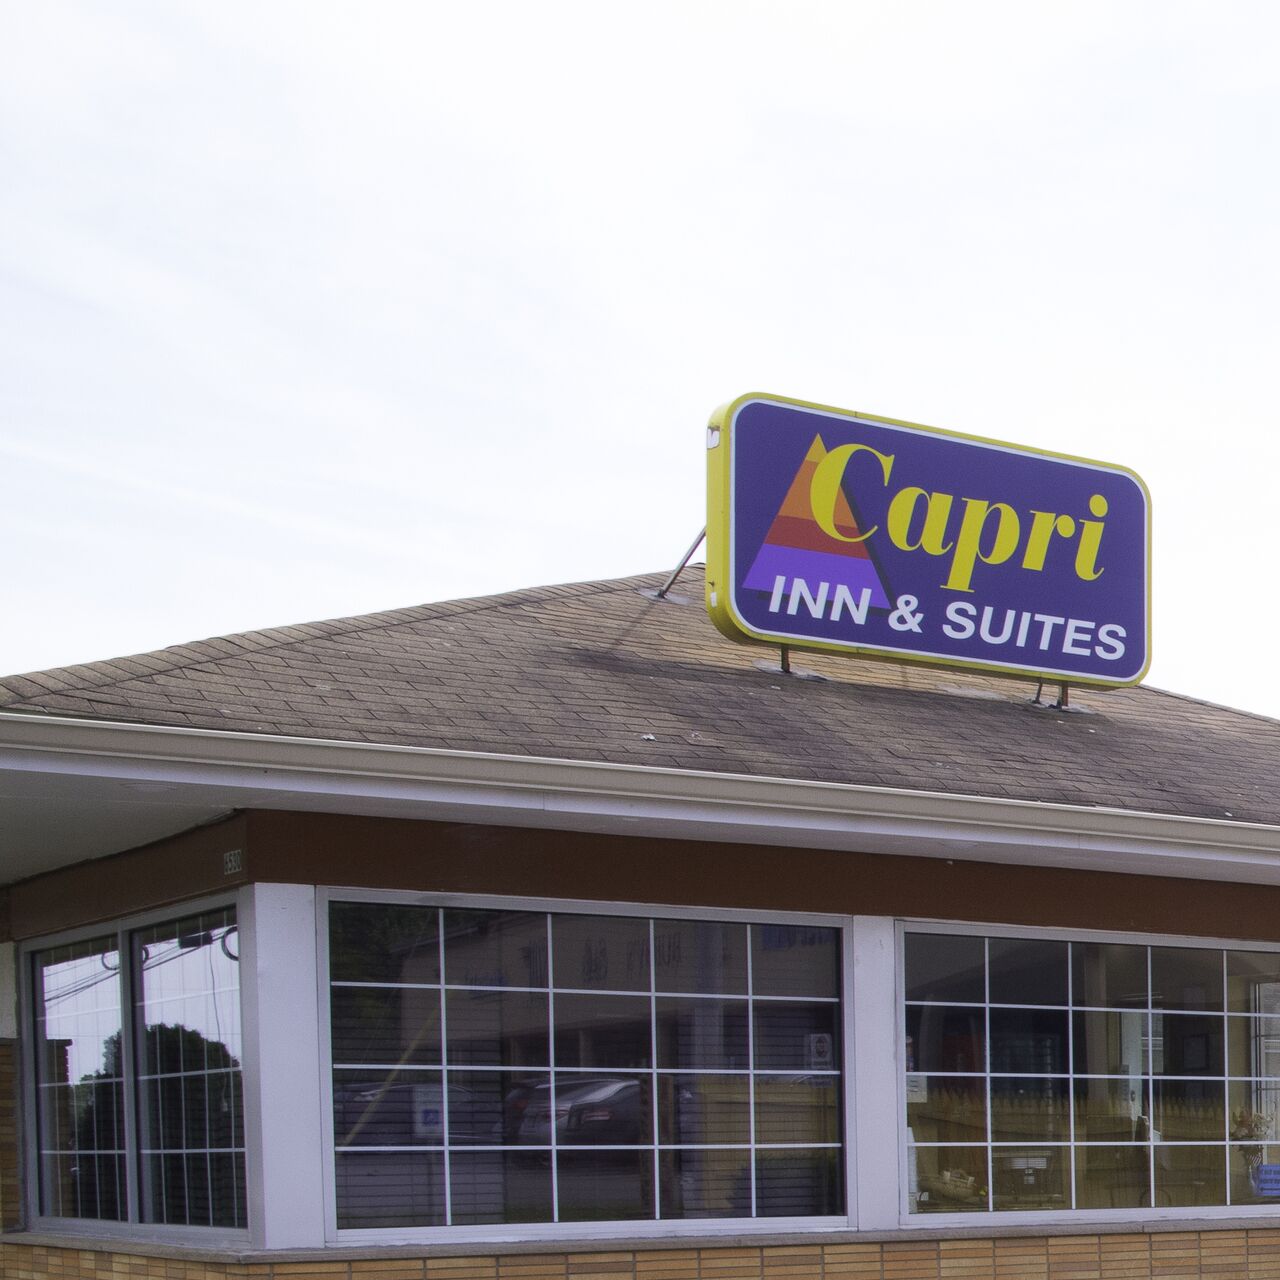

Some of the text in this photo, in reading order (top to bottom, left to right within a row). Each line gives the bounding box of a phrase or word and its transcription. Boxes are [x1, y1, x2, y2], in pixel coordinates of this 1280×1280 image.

[810, 443, 1108, 593] Capri
[769, 575, 1127, 660] INN & SUITES
